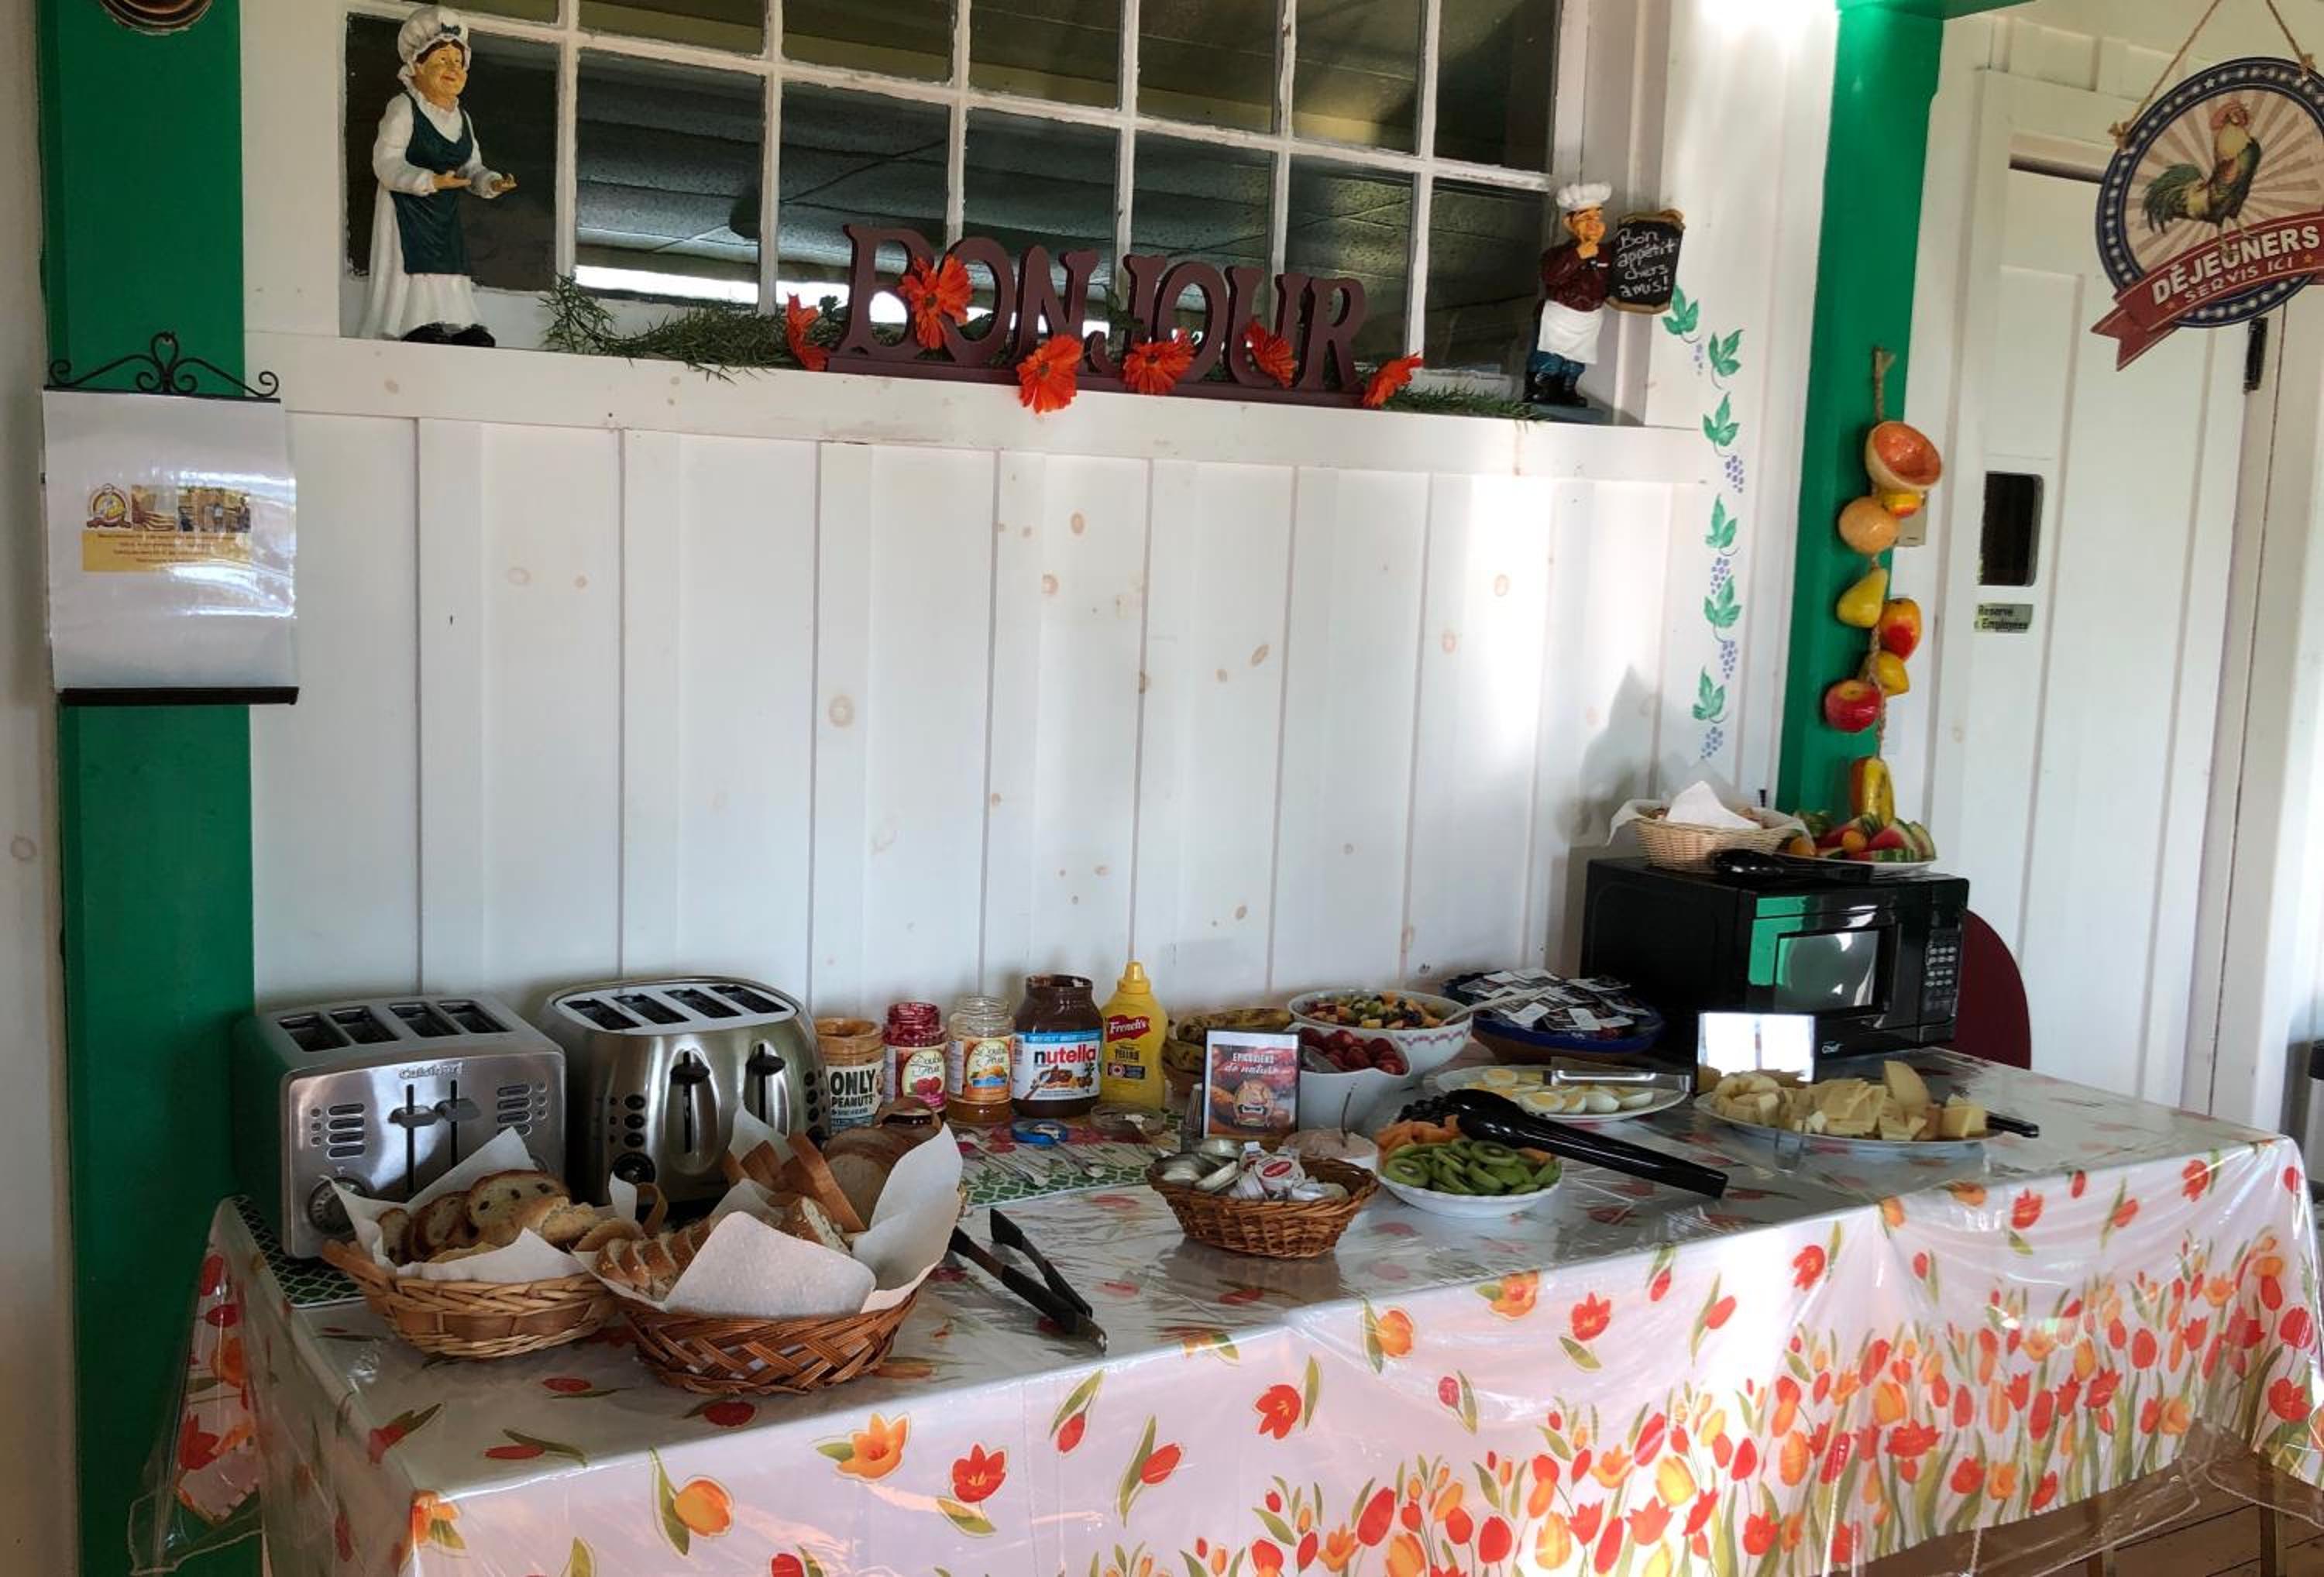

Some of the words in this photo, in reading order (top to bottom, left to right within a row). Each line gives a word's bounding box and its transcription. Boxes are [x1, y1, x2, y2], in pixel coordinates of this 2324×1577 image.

[1616, 228, 1659, 249] Bon
[2185, 266, 2258, 303] SERVIS
[2267, 257, 2293, 273] ICI
[836, 223, 1367, 392] BONJOUR
[1109, 1018, 1147, 1035] French's
[1034, 1043, 1097, 1063] nutella
[830, 1069, 876, 1096] ONLY
[831, 1095, 874, 1108] PEANUTS
